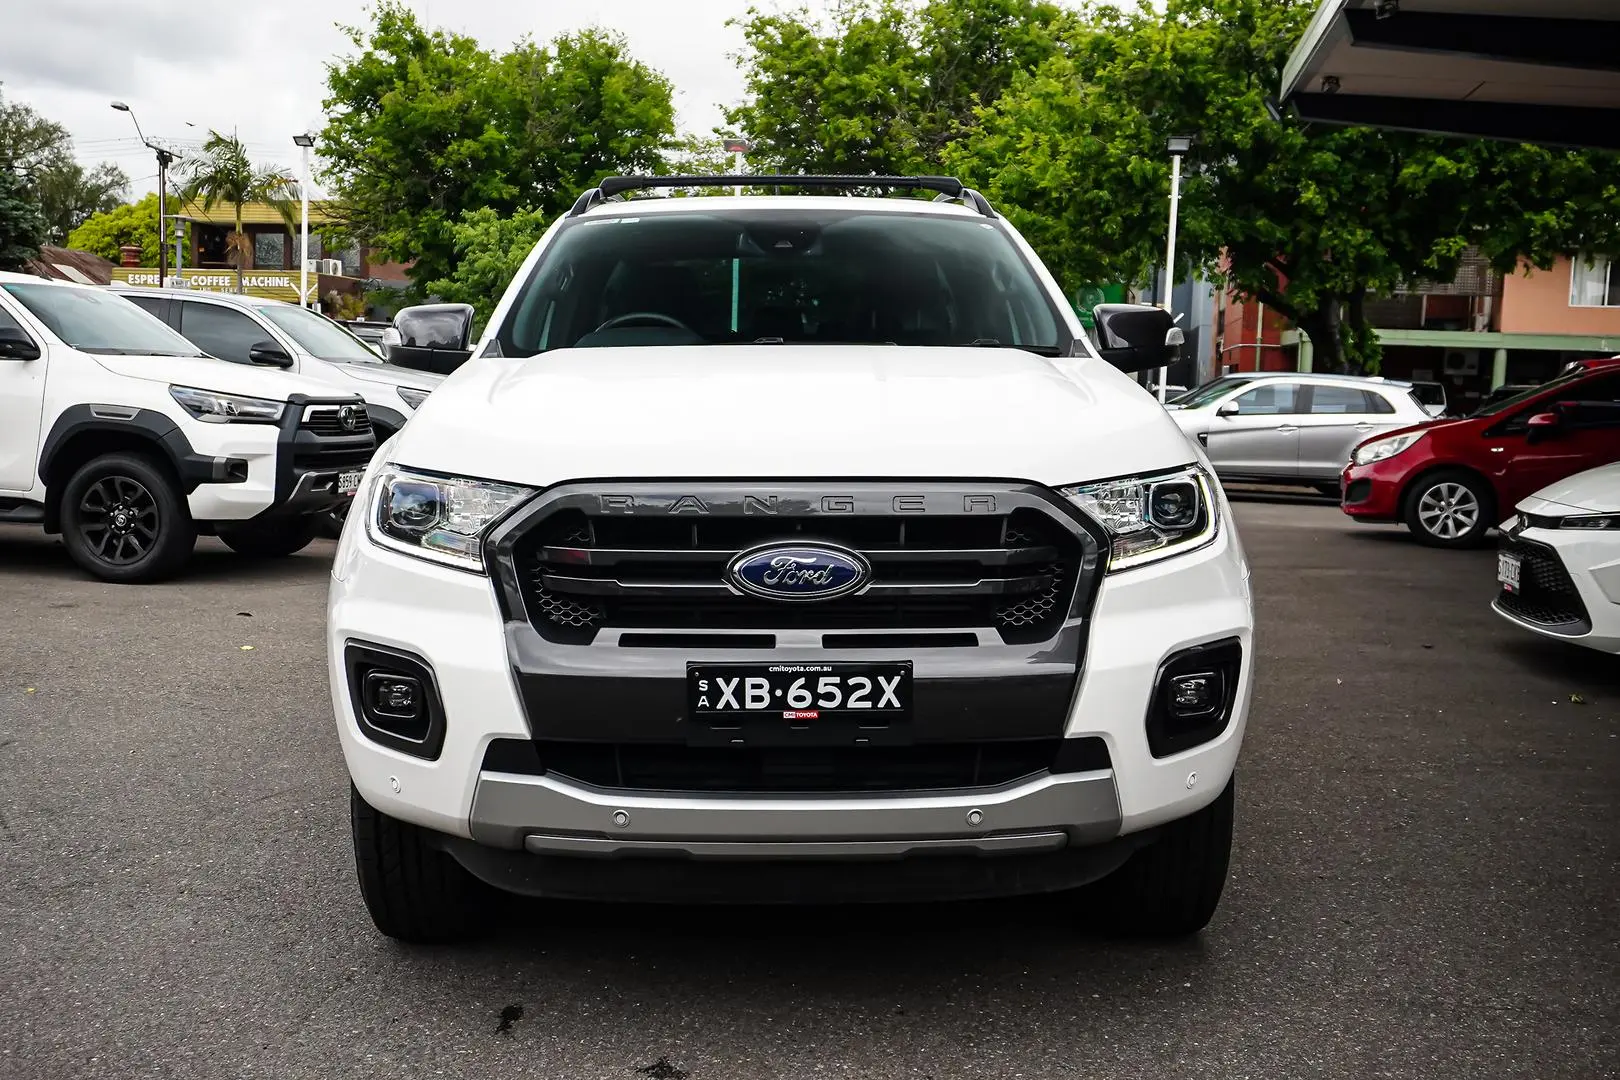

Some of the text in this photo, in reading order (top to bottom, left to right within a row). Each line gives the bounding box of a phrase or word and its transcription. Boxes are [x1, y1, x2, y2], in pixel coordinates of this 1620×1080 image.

[128, 274, 290, 287] ESPRE COFFEE MACHINE
[600, 494, 997, 514] RANGER
[763, 555, 837, 587] Ford
[769, 664, 832, 673] cmitoyota.com.au
